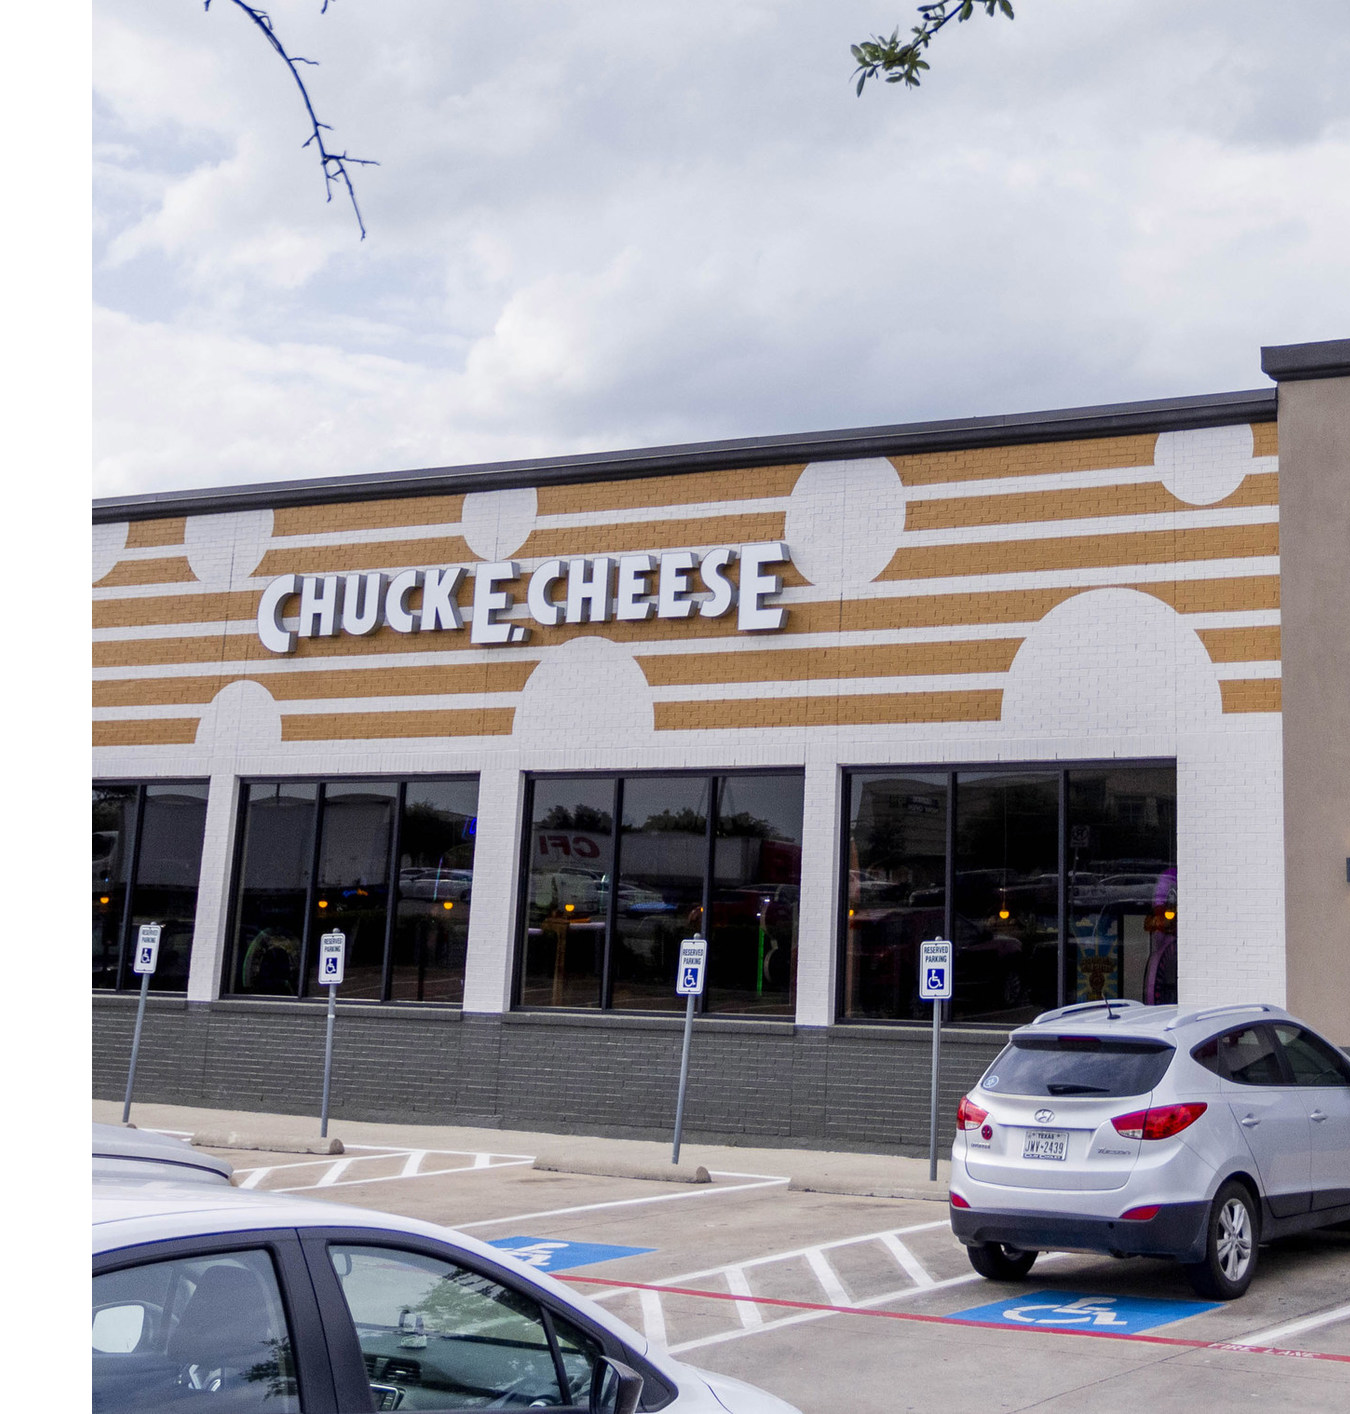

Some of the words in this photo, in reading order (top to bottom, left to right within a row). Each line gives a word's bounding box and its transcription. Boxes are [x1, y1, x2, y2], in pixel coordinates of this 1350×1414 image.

[257, 567, 468, 653] CHUCK
[527, 542, 790, 631] CHEESE
[926, 955, 947, 963] PARKING
[1208, 1343, 1256, 1351] FIRE
[1264, 1349, 1321, 1357] LANE
